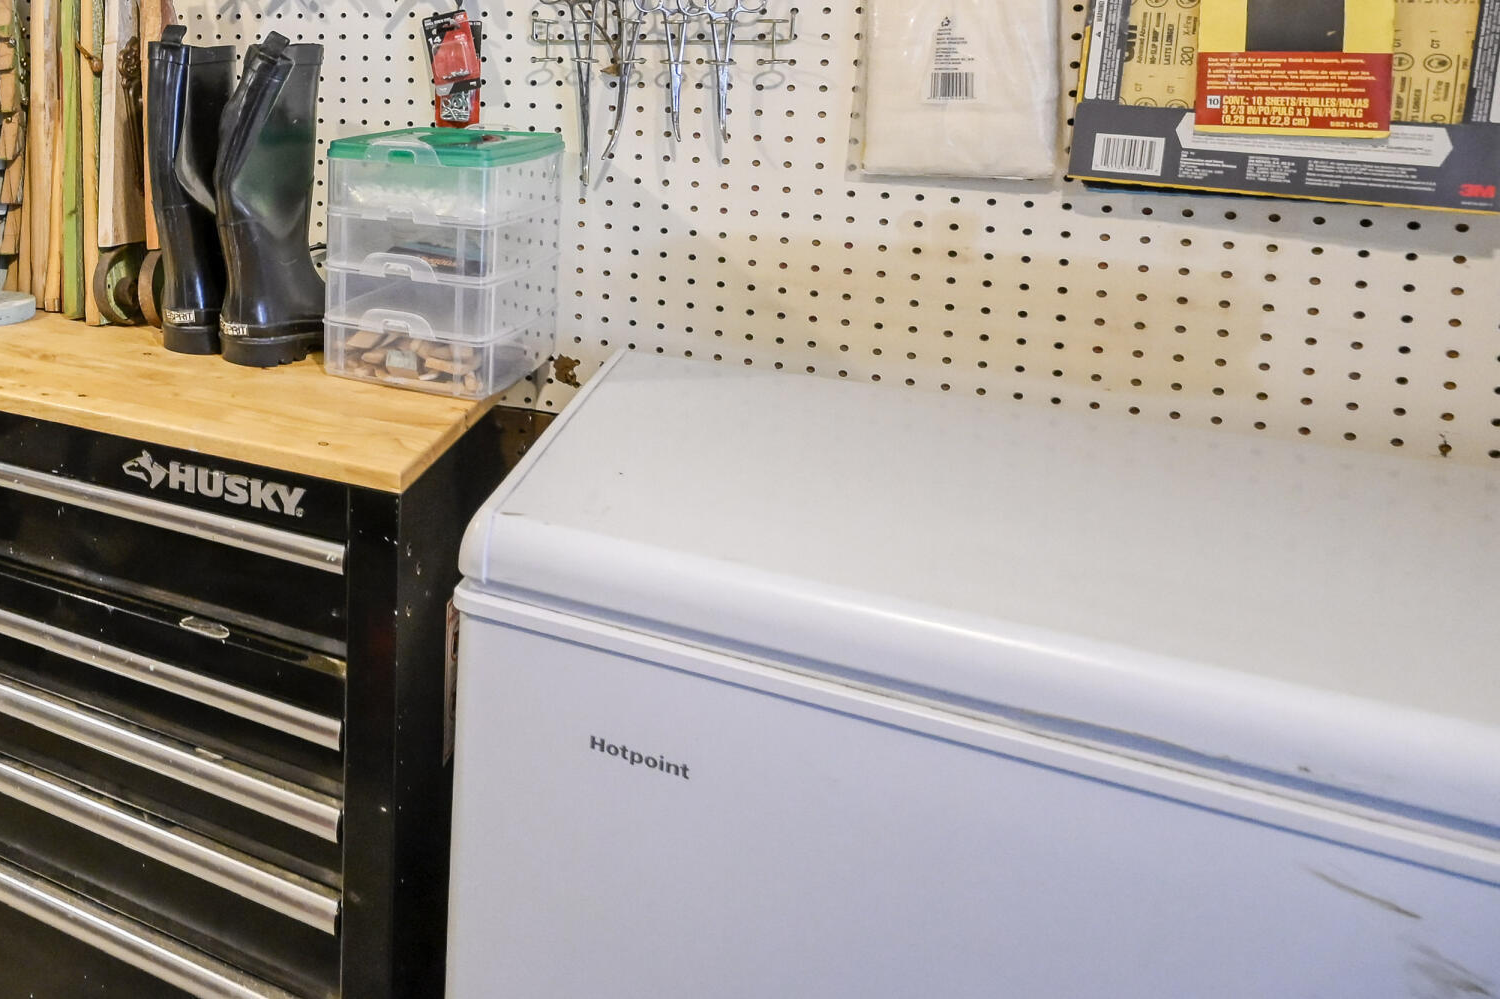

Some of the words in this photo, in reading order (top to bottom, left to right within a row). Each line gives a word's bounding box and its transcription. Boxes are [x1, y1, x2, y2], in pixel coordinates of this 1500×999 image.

[428, 35, 442, 45] 14
[1165, 24, 1175, 46] LONGER
[1430, 39, 1440, 49] CT
[1164, 47, 1173, 65] LASTS
[1181, 46, 1195, 66] 320
[1209, 98, 1219, 106] 10
[1252, 96, 1263, 106] 10
[1222, 105, 1228, 114] 3
[1247, 116, 1260, 124] cm
[1459, 183, 1496, 198] 3M
[590, 735, 690, 780] Hotpoint
